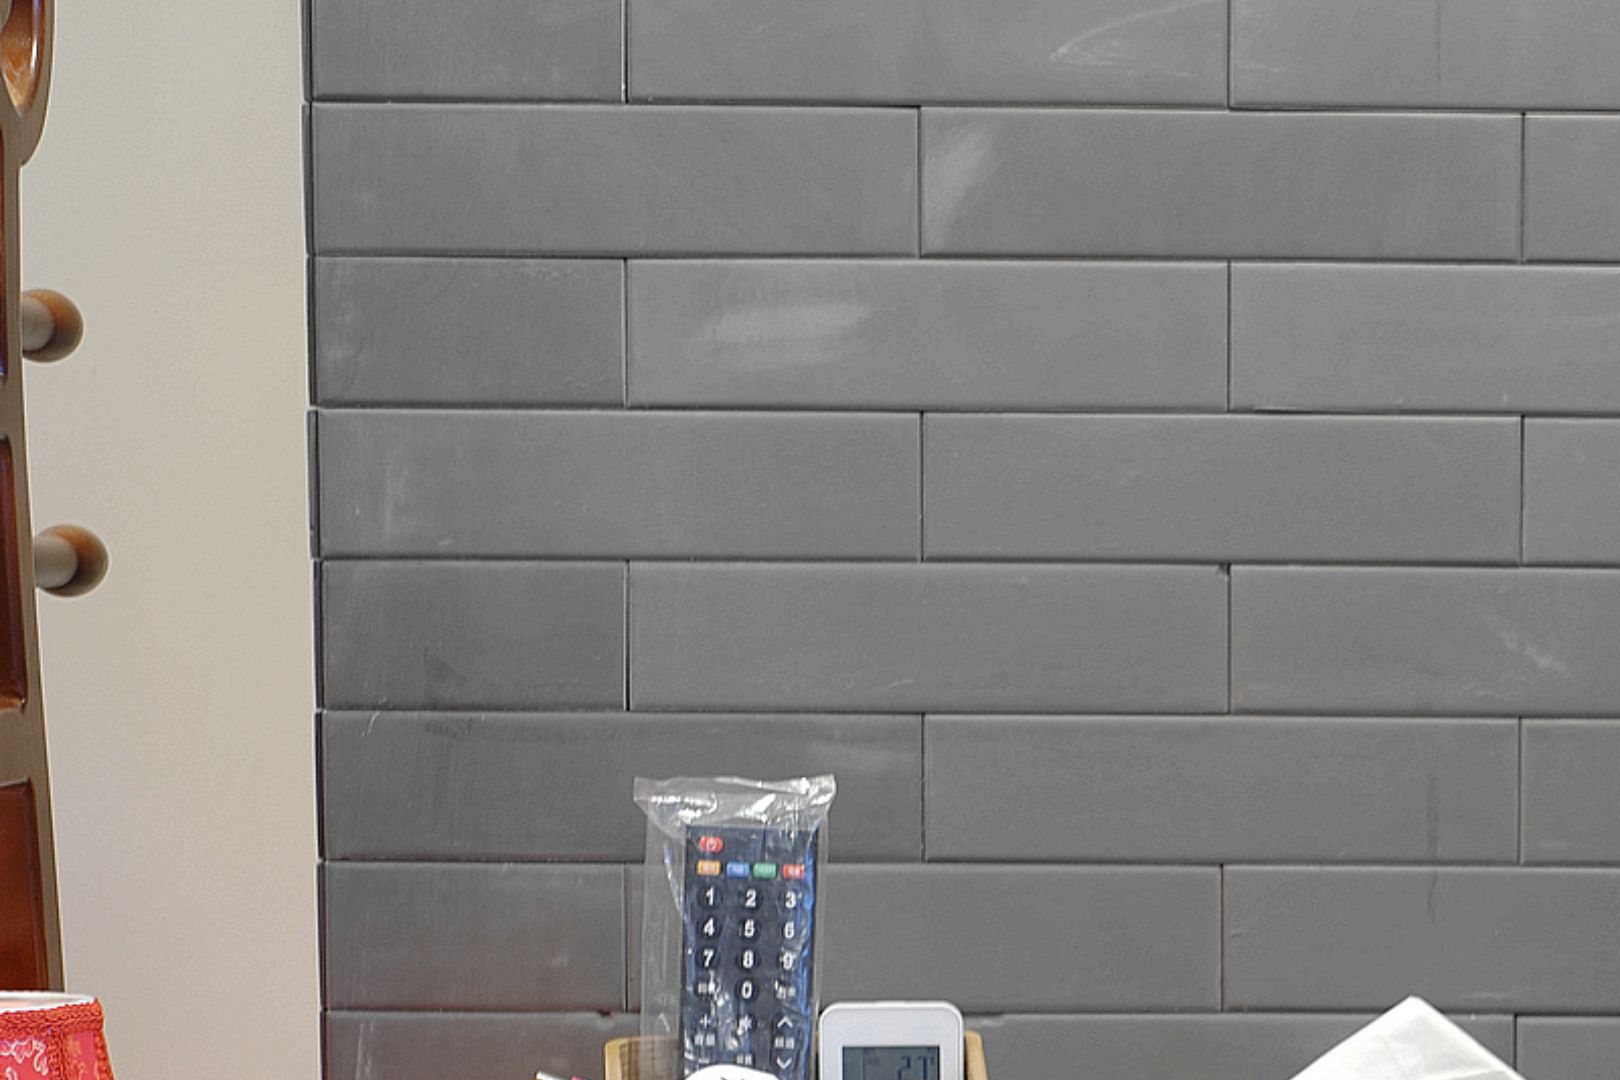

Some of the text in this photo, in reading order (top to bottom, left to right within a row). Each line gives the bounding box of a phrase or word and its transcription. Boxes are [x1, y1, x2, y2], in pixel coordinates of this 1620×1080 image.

[706, 887, 797, 908] 1 2 3
[704, 917, 795, 939] 4 5 6
[703, 948, 714, 967] 7
[742, 949, 754, 968] 8
[741, 980, 752, 999] 0
